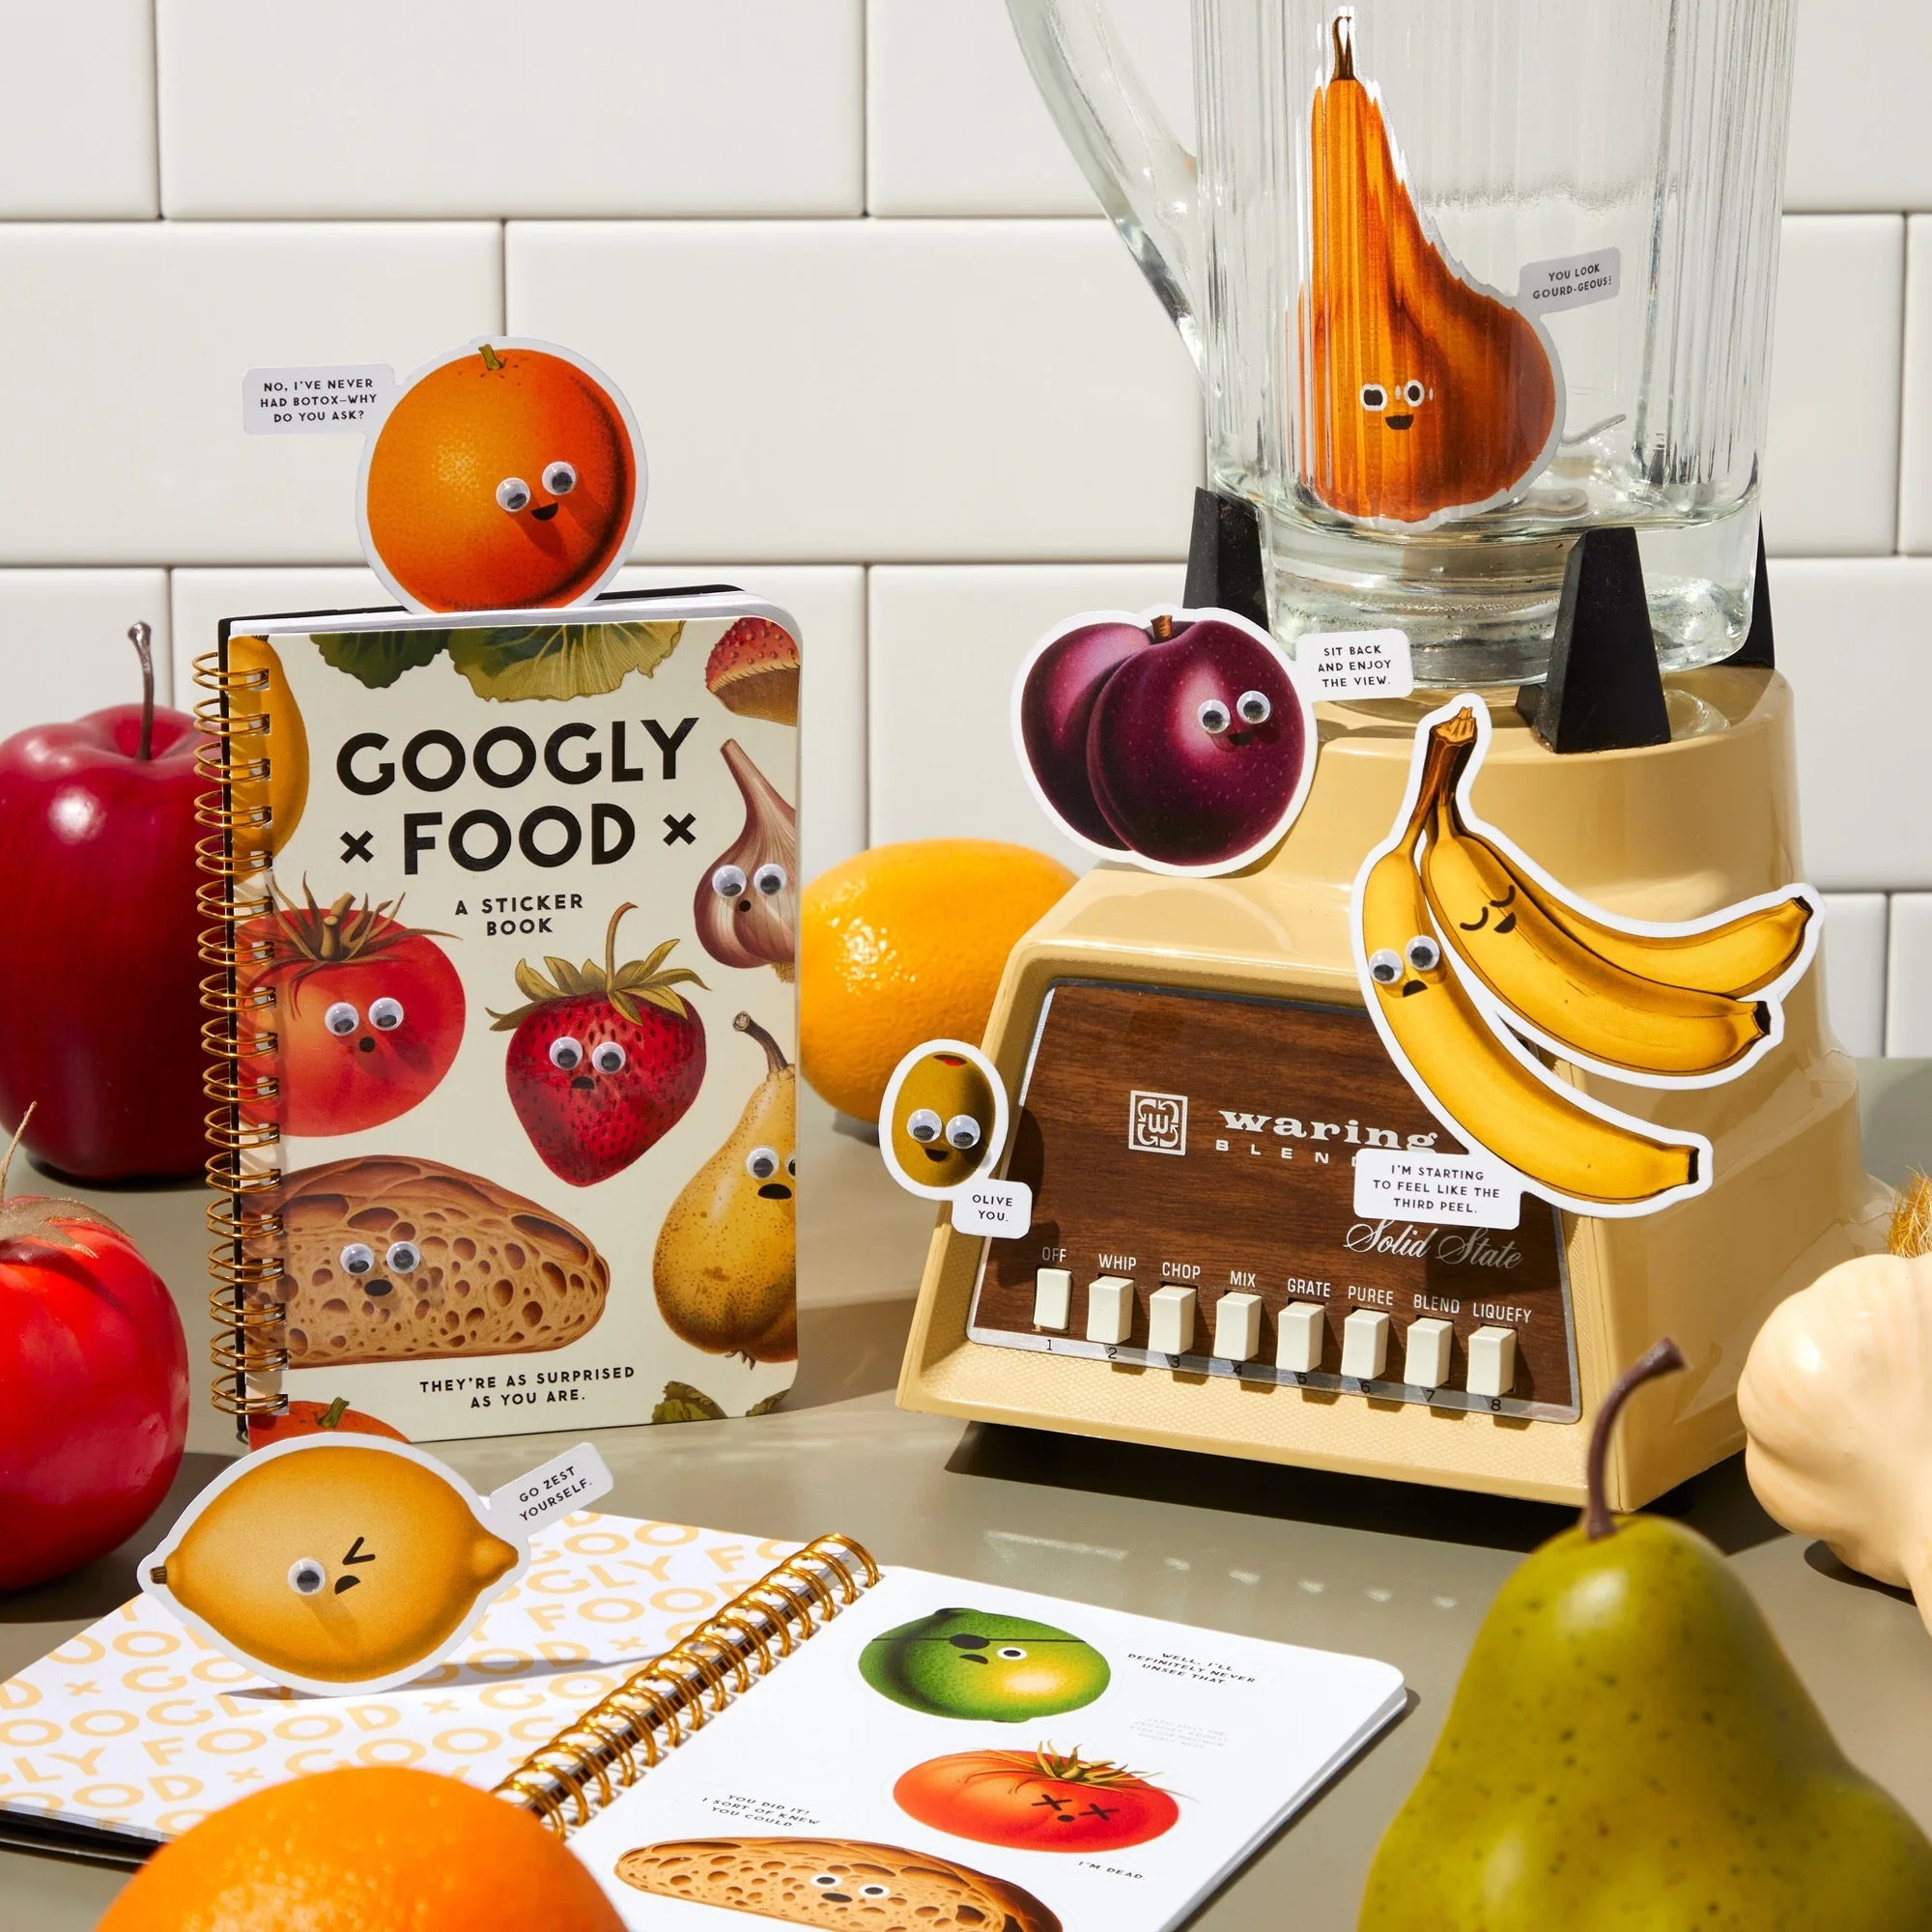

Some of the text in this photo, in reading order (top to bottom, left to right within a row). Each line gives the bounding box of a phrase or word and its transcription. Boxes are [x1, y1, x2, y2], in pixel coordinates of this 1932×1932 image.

[1548, 264, 1600, 281] YOU LOOK
[1533, 275, 1612, 298] GOURD-GEOUS!
[264, 379, 373, 391] NO, I'VE NEVER
[261, 398, 287, 408] HAD
[274, 410, 364, 422] DO YOU ASK?
[1323, 644, 1381, 656] SIT BACK
[1319, 660, 1391, 672] AND ENJOY
[1322, 676, 1391, 687] THE VIEW.
[336, 717, 699, 796] GOOGLY
[404, 803, 636, 875] FOOD
[455, 894, 583, 916] A STICKER
[487, 917, 553, 936] BOOK
[1218, 1110, 1438, 1152] waring
[1391, 1165, 1484, 1180] I'M STARTING
[1373, 1179, 1500, 1199] TO FEEL LIKE THE
[972, 1194, 1012, 1207] OLIVE
[1393, 1198, 1478, 1213] THIRD PEEL.
[979, 1210, 1009, 1222] YOU.
[1343, 1219, 1522, 1269] Solid State
[1042, 1246, 1532, 1324] OFF WHIP CHOP MIX GRATE PUREE BLEND LIQUEFY
[419, 1366, 635, 1393] THEY'RE AS SURPRISED
[1046, 1339, 1501, 1411] 1 2 3 4 5 6 7 8
[470, 1388, 585, 1408] AS YOU ARE.
[519, 1465, 575, 1502] GO ZEST
[519, 1478, 592, 1521] YOURSELF.
[1127, 1654, 1256, 1683] DEFINITELY NEVER
[1142, 1663, 1186, 1677] UNSEE
[1208, 1662, 1233, 1671] I'LL
[141, 1704, 402, 1767] FOOD
[728, 1795, 756, 1804] YOU
[712, 1806, 740, 1816] YOU
[713, 1800, 750, 1810] SORT
[778, 1813, 820, 1825] KNEW
[1078, 1861, 1101, 1870] I'M
